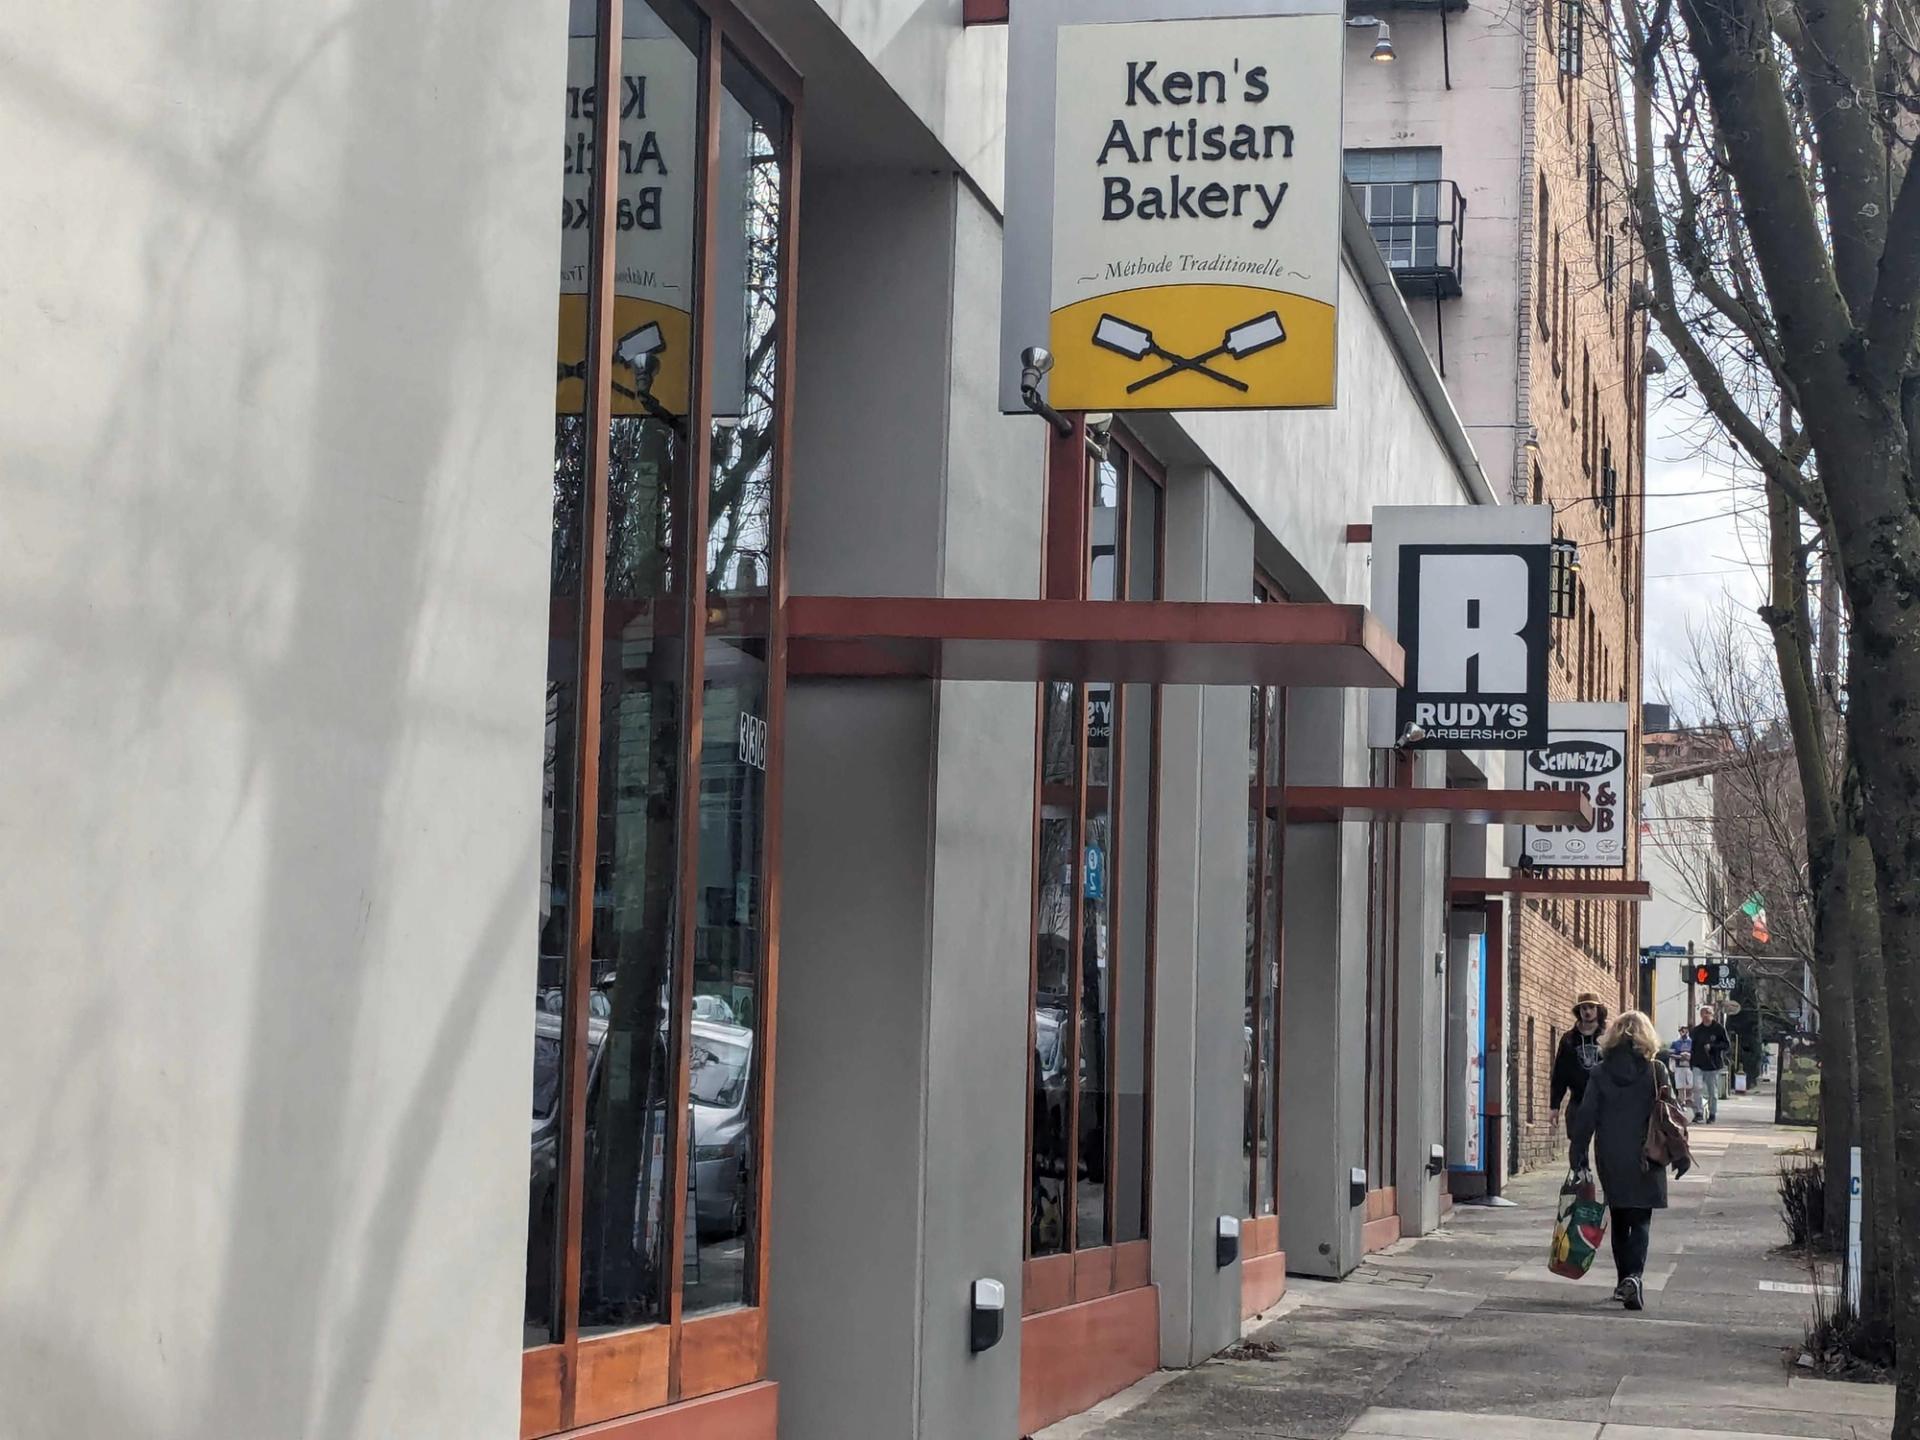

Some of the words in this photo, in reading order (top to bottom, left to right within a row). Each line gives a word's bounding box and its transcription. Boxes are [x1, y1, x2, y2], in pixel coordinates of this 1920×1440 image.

[1125, 58, 1270, 106] Ken's
[1096, 118, 1294, 166] Artisan
[1102, 175, 1288, 229] Bakery
[1104, 254, 1173, 281] Méthode
[1179, 253, 1285, 278] Traditionelle
[1417, 554, 1529, 694] R
[1415, 702, 1528, 727] RUDY'S
[739, 711, 767, 771] 338
[1535, 807, 1615, 833] UB
